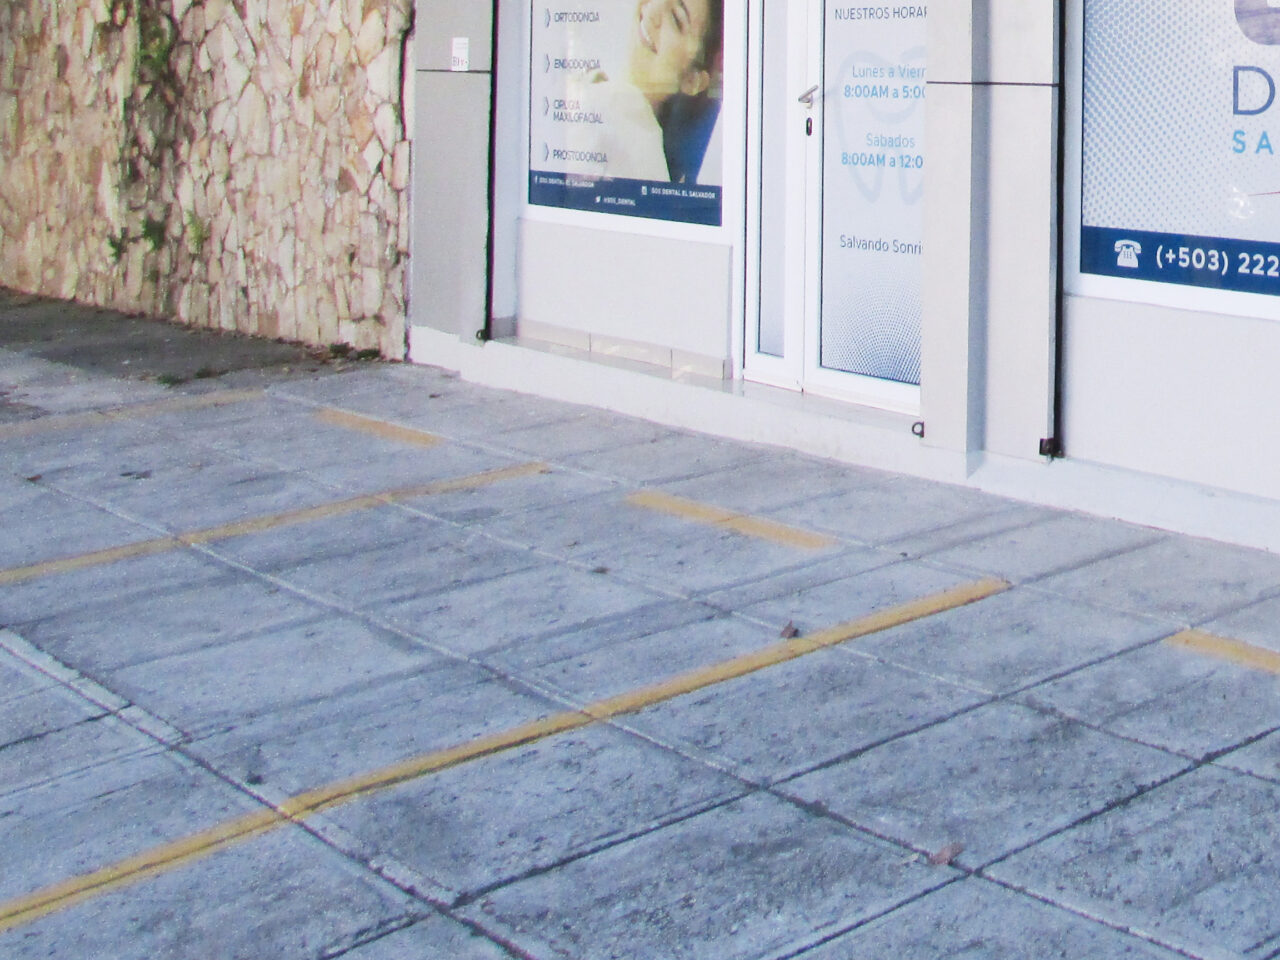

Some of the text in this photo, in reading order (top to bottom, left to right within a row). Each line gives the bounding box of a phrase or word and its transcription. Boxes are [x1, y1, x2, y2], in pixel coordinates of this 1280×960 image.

[554, 11, 600, 23] ORTODONCIA
[834, 7, 890, 20] NUESTROS
[554, 58, 600, 70] ENDODONCIA
[852, 64, 885, 78] Lunes
[888, 67, 895, 78] a
[844, 84, 889, 99] 8:00AM
[892, 88, 899, 99] a
[553, 111, 604, 124] MAXILOFACIAL
[552, 149, 608, 163] PROSTODONCIA
[841, 151, 886, 167] 8:00AM
[889, 156, 896, 168] a
[661, 188, 680, 196] DENTAL
[688, 190, 716, 199] SALVADOR
[839, 234, 923, 255] Salvando Sonri
[1156, 244, 1229, 276] (+503)
